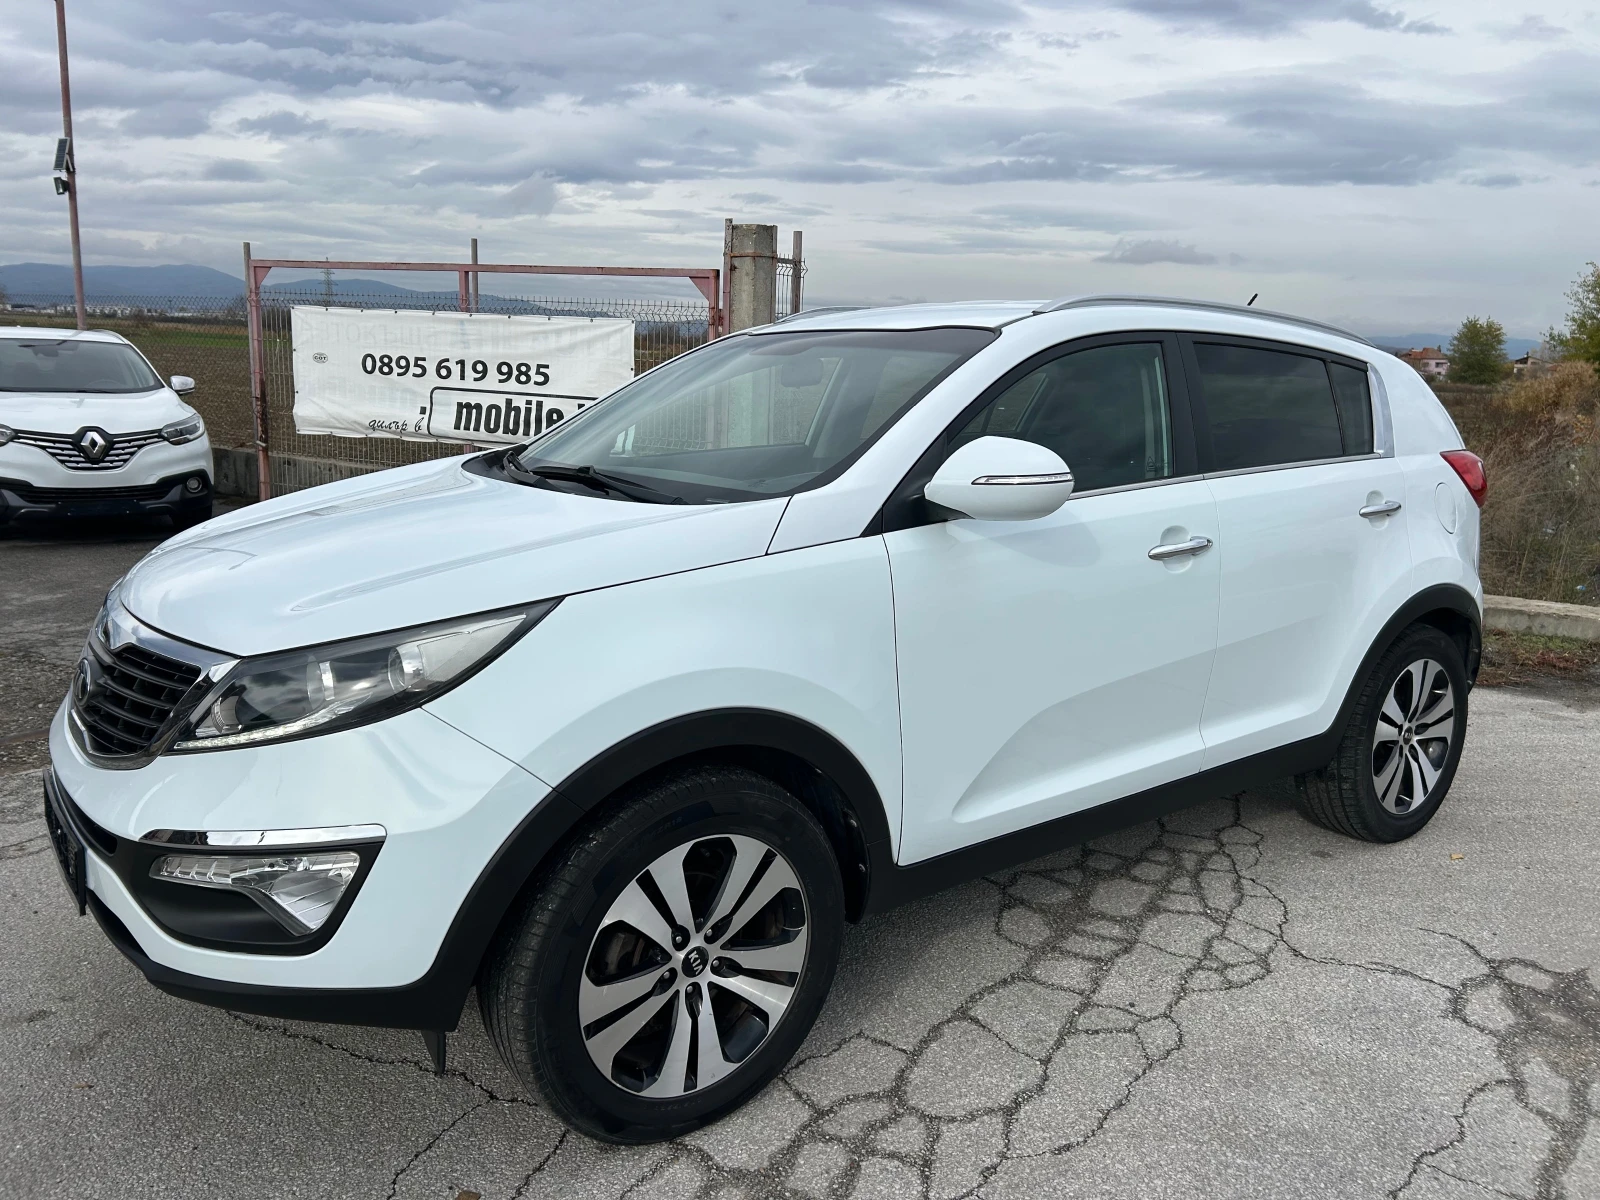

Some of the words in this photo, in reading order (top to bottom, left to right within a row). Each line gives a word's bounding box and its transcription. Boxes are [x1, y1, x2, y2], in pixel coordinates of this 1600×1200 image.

[361, 353, 427, 378] 0895
[435, 357, 489, 382] 619
[496, 361, 550, 386] 985
[454, 397, 586, 437] mobile
[688, 950, 703, 975] KIA
